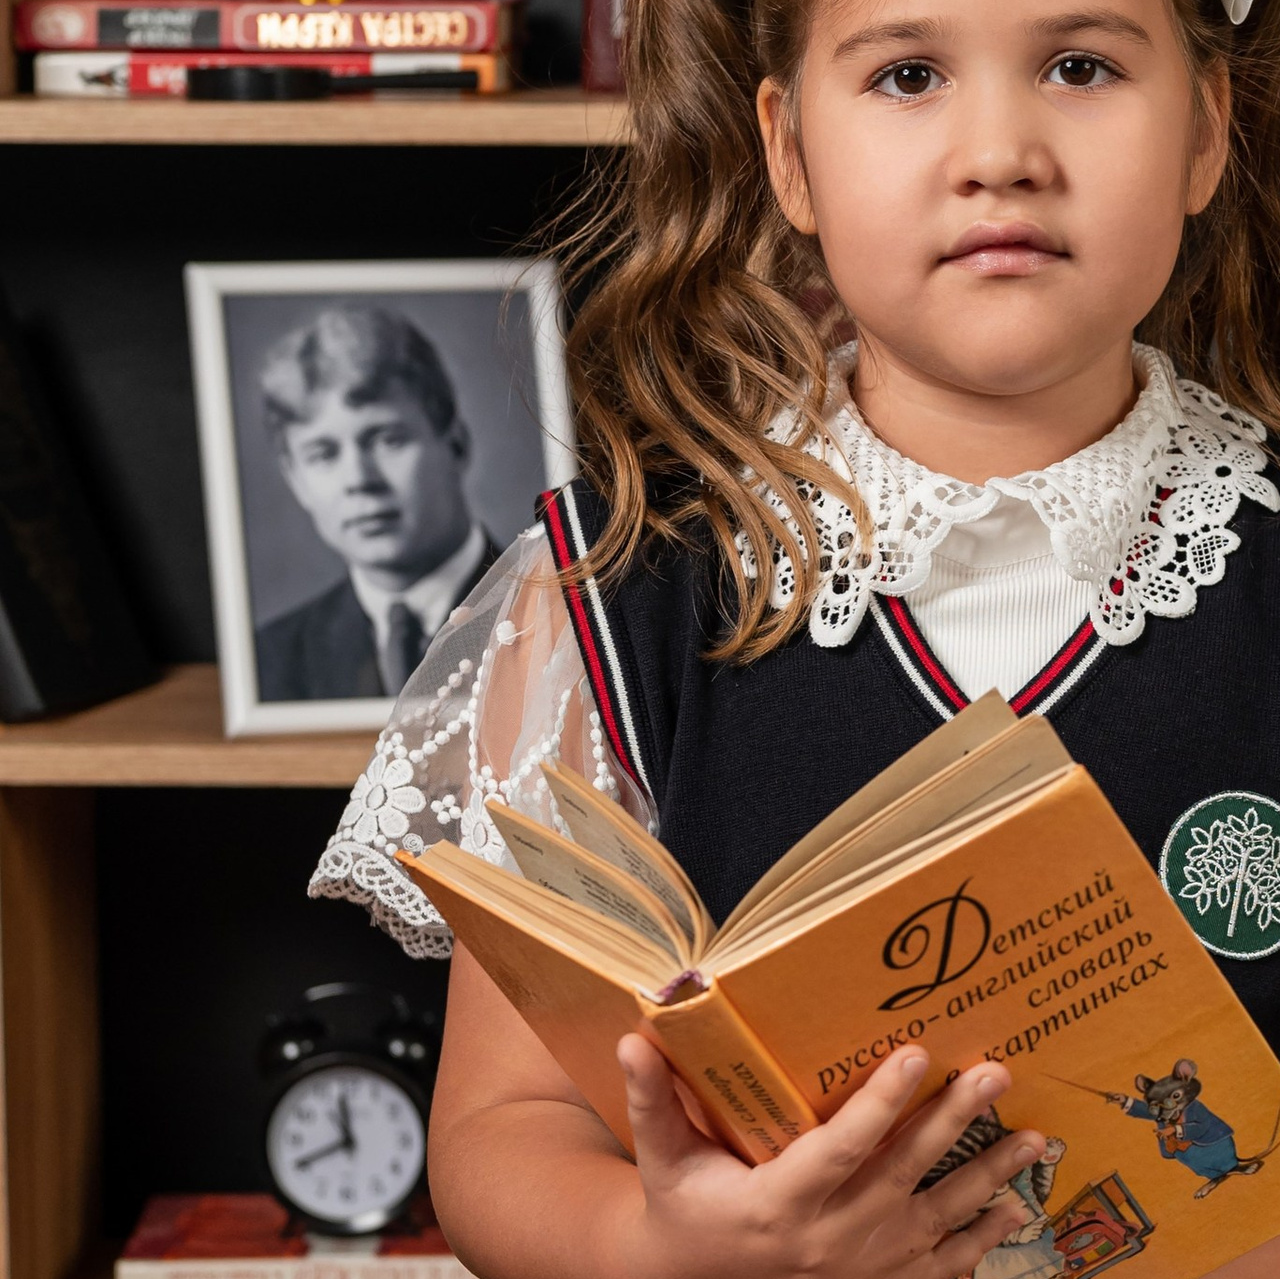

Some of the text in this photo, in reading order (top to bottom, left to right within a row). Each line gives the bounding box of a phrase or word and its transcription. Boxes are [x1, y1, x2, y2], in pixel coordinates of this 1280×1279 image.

[875, 868, 1115, 1012] Детский
[1026, 929, 1154, 1009] словарь
[983, 951, 1170, 1064] картинках
[728, 1061, 800, 1140] артинках
